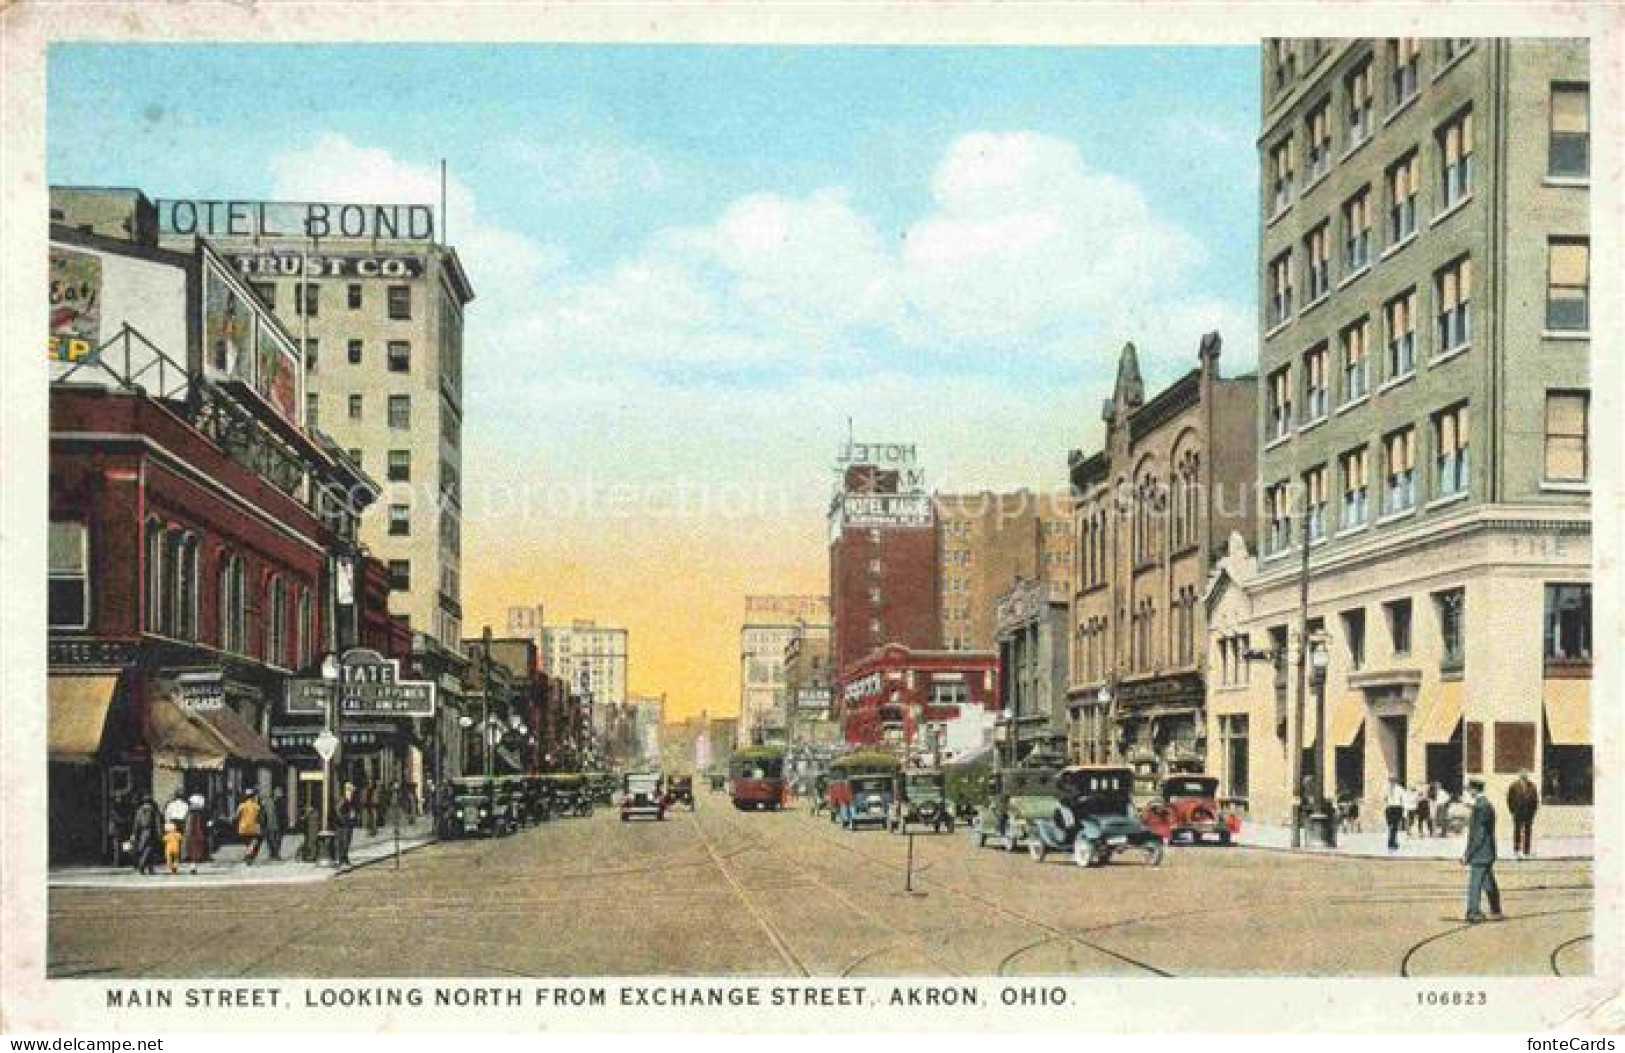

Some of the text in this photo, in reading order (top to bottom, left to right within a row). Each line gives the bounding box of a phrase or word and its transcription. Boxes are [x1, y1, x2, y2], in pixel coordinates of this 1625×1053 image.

[156, 200, 433, 239] OTEL BOND
[236, 256, 412, 276] TRUST CO.
[1509, 536, 1568, 557] THE
[106, 989, 172, 1006] MAIN
[305, 988, 423, 1006] LOOKING
[435, 988, 521, 1006] NORTH
[536, 988, 605, 1006] FROM
[621, 987, 760, 1006] EXCHANGE
[1416, 991, 1487, 1006] 106823
